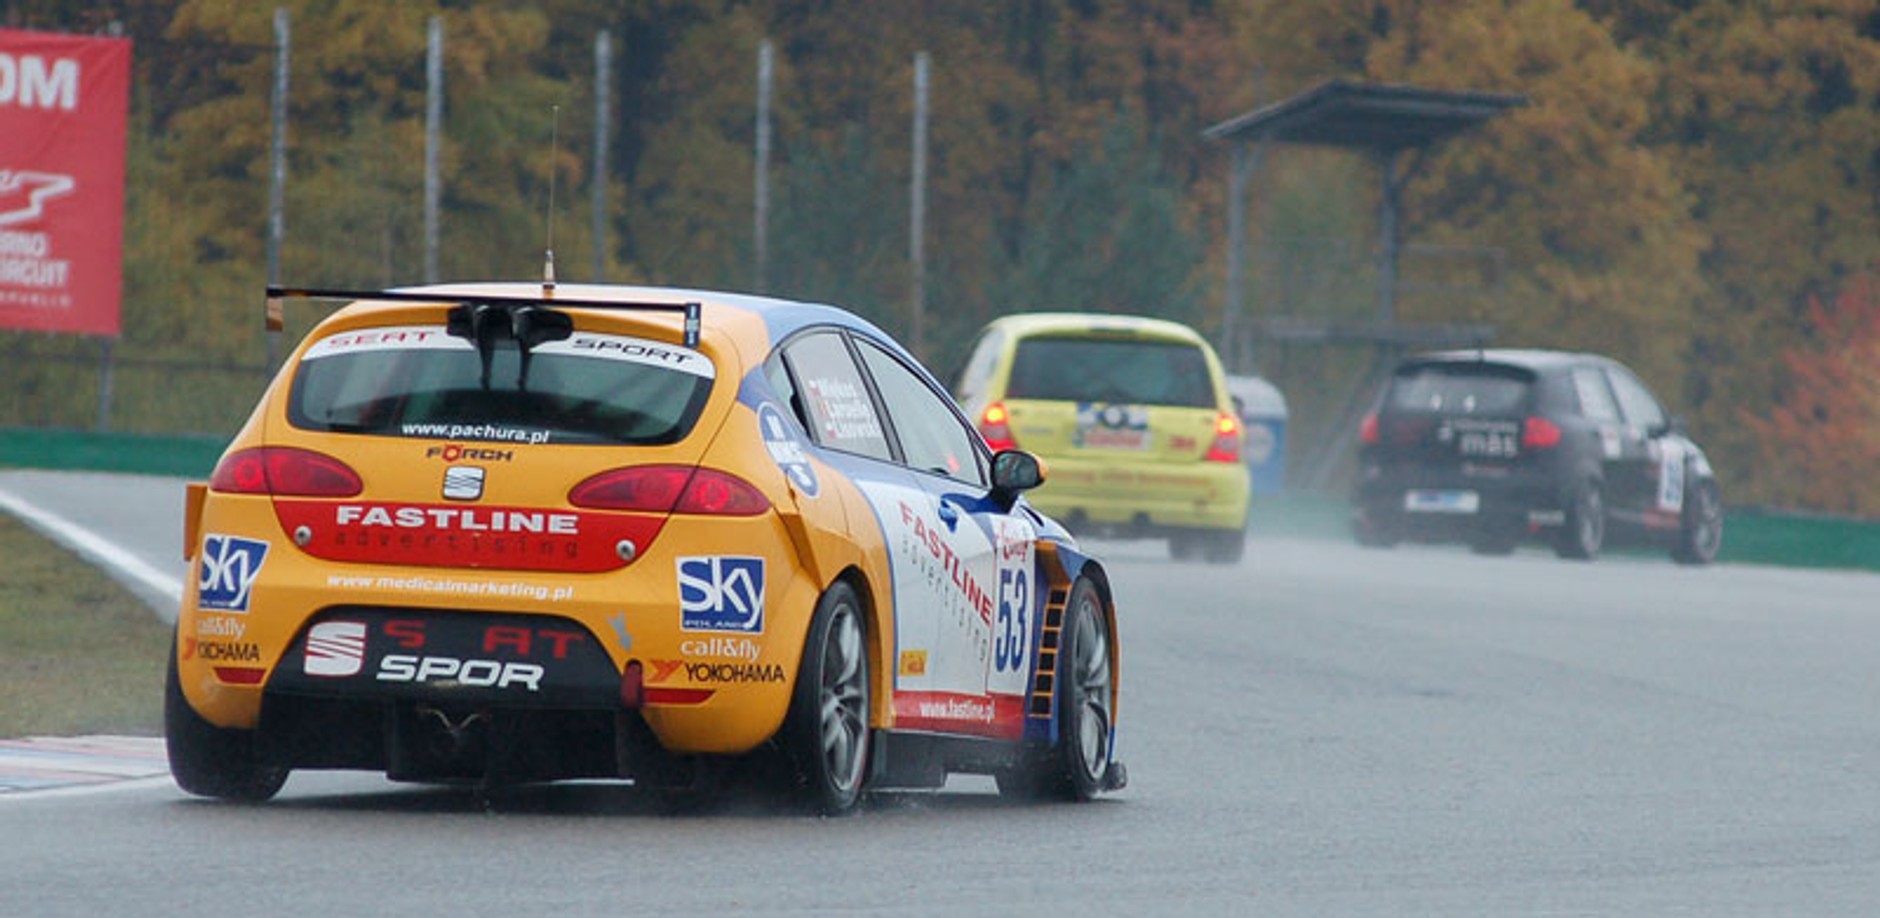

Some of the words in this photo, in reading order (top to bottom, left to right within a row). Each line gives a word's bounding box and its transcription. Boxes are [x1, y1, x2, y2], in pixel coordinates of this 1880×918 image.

[329, 330, 437, 346] SEAT
[572, 337, 693, 365] SPORT
[401, 421, 550, 444] www.pachura.pl
[335, 504, 579, 534] FASTLINE
[334, 532, 578, 558] advertising
[900, 500, 993, 627] FASTLINE
[327, 574, 573, 600] www.medicalmarketing.pl
[677, 557, 765, 629] Sky
[995, 567, 1028, 672] 53
[681, 638, 761, 661] call&fly
[376, 655, 545, 690] SPOR
[684, 663, 786, 683] YOKOHAMA
